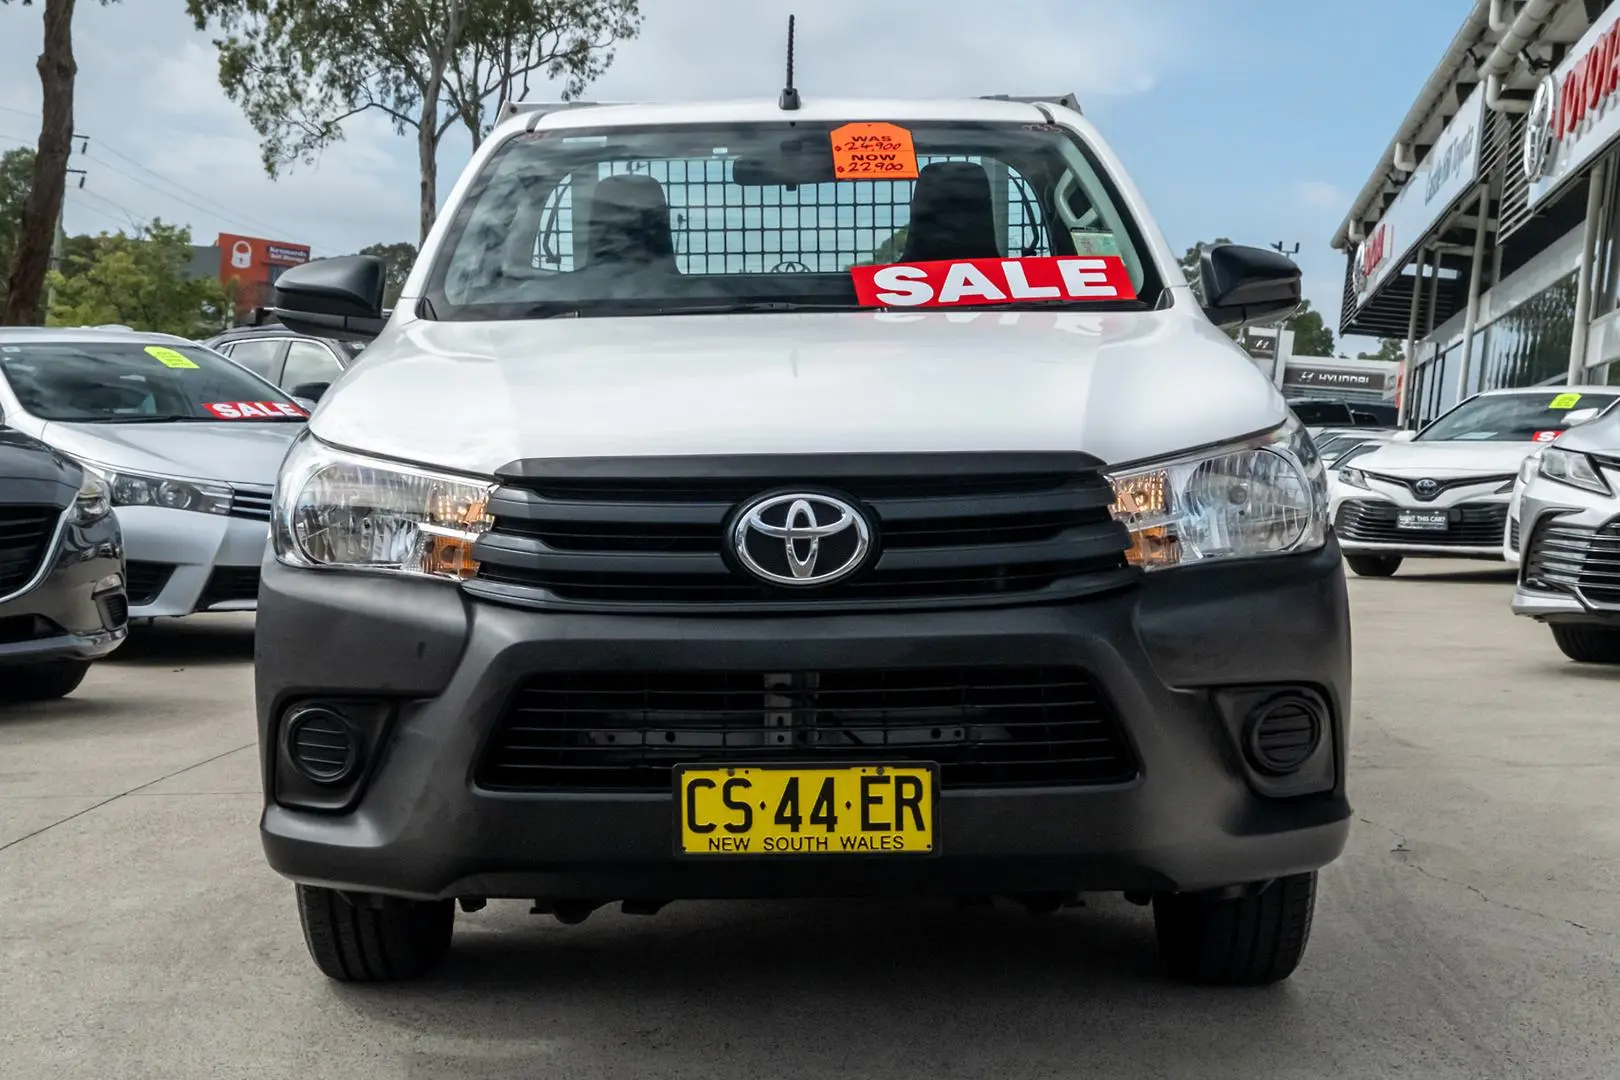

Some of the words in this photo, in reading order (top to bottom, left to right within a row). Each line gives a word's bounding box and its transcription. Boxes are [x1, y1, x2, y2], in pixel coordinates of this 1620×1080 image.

[873, 259, 1118, 306] SALE
[212, 403, 302, 418] SALE
[708, 837, 751, 851] NEW
[763, 837, 828, 851] SOUTH
[840, 836, 905, 850] WALES
